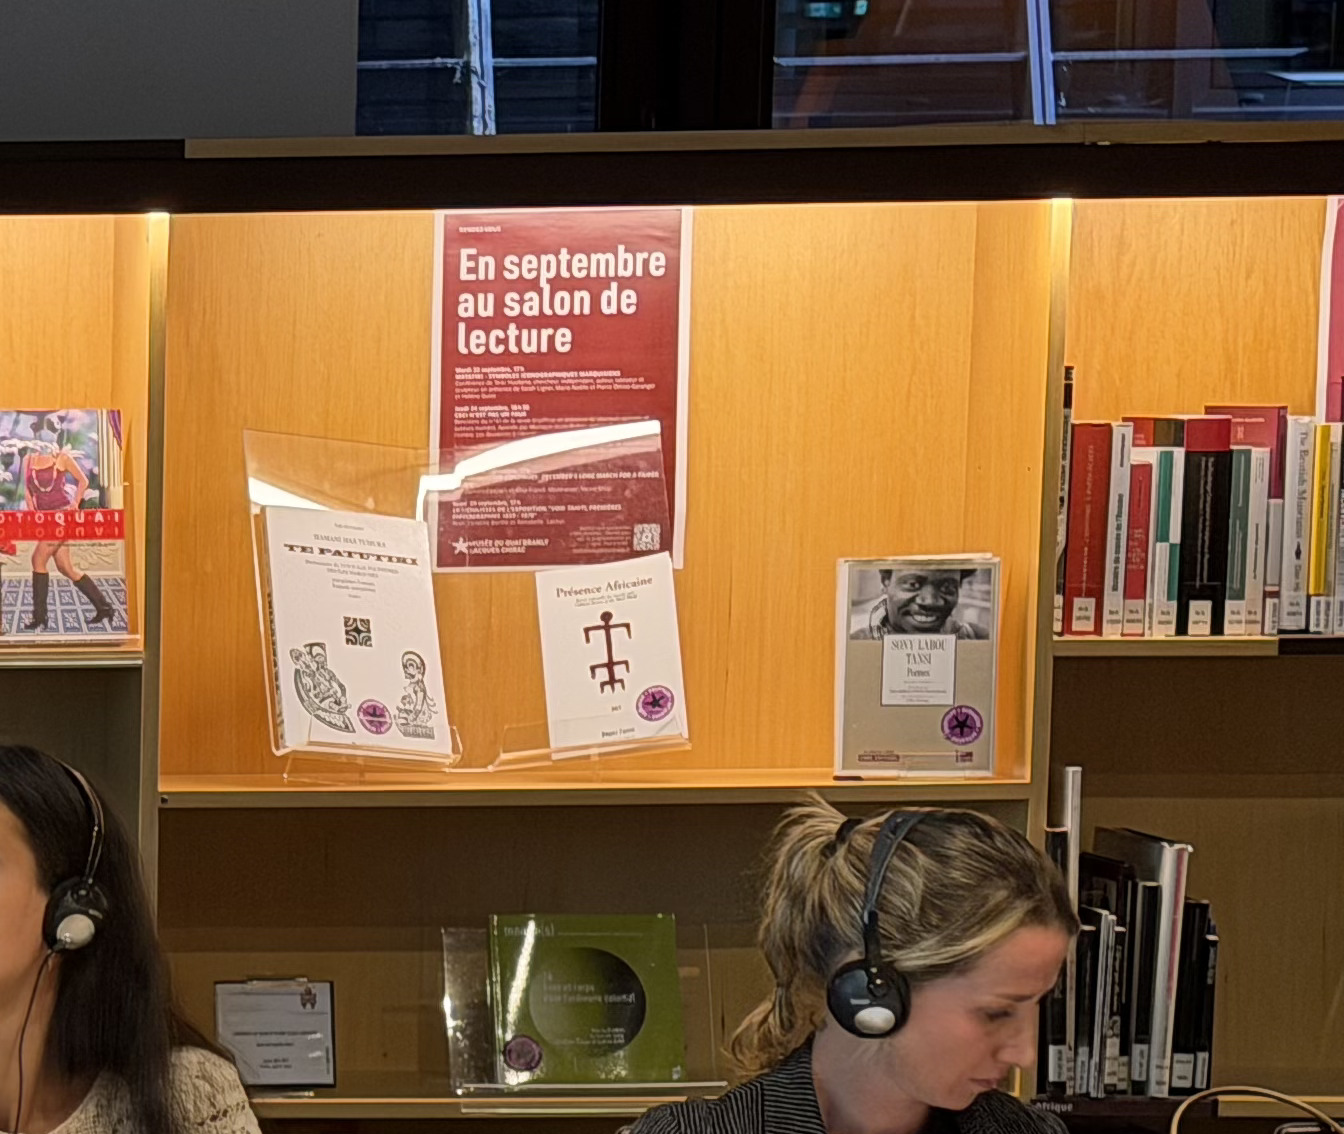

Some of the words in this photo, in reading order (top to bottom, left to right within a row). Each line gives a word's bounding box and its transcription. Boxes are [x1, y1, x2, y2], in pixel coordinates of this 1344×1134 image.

[459, 248, 495, 281] En
[503, 244, 666, 288] septembre
[458, 292, 495, 318] au
[503, 283, 590, 317] salon
[600, 282, 637, 315] de
[457, 322, 572, 355] lecture
[284, 543, 314, 554] TE
[318, 547, 419, 565] PATUTIKI
[556, 585, 601, 598] Présence
[605, 577, 653, 592] Africaine
[891, 639, 913, 651] SONY
[917, 639, 947, 651] LABOU
[906, 653, 932, 665] TANSI
